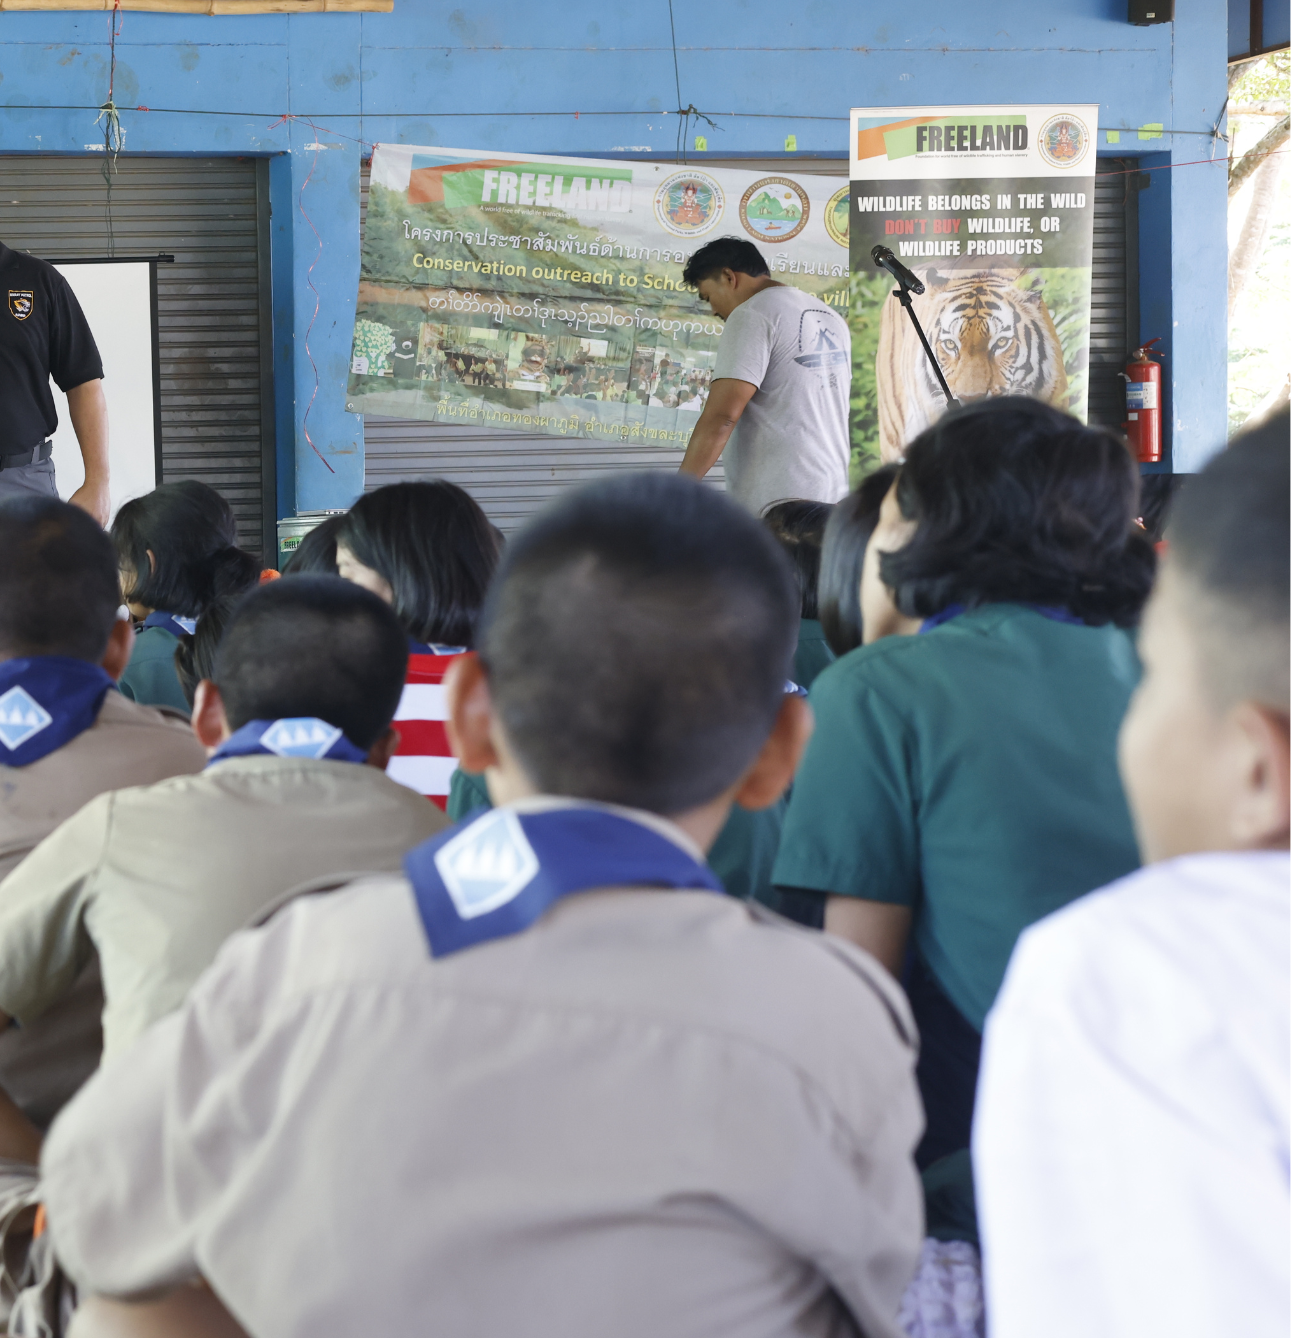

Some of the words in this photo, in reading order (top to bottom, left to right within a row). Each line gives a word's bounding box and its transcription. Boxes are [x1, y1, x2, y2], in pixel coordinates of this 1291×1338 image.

[916, 124, 1028, 152] FREELAND
[481, 170, 632, 213] FREELAND
[858, 195, 922, 212] WILDLIFE
[928, 194, 990, 211] BELONGS
[997, 194, 1011, 210] IN
[1018, 193, 1044, 209] THE
[1051, 193, 1086, 209] WILD
[885, 219, 927, 235] DON'T
[933, 218, 961, 235] BUY
[967, 217, 1034, 234] WILDLIFE,
[1040, 217, 1060, 232] OR
[403, 219, 692, 263] โครงการประชาสัมพันธ์ด้านการอ
[899, 241, 960, 257] WILDLIFE
[967, 239, 1043, 256] PRODUCTS
[412, 253, 527, 277] Conservation
[531, 266, 613, 285] outreach
[619, 272, 638, 287] to
